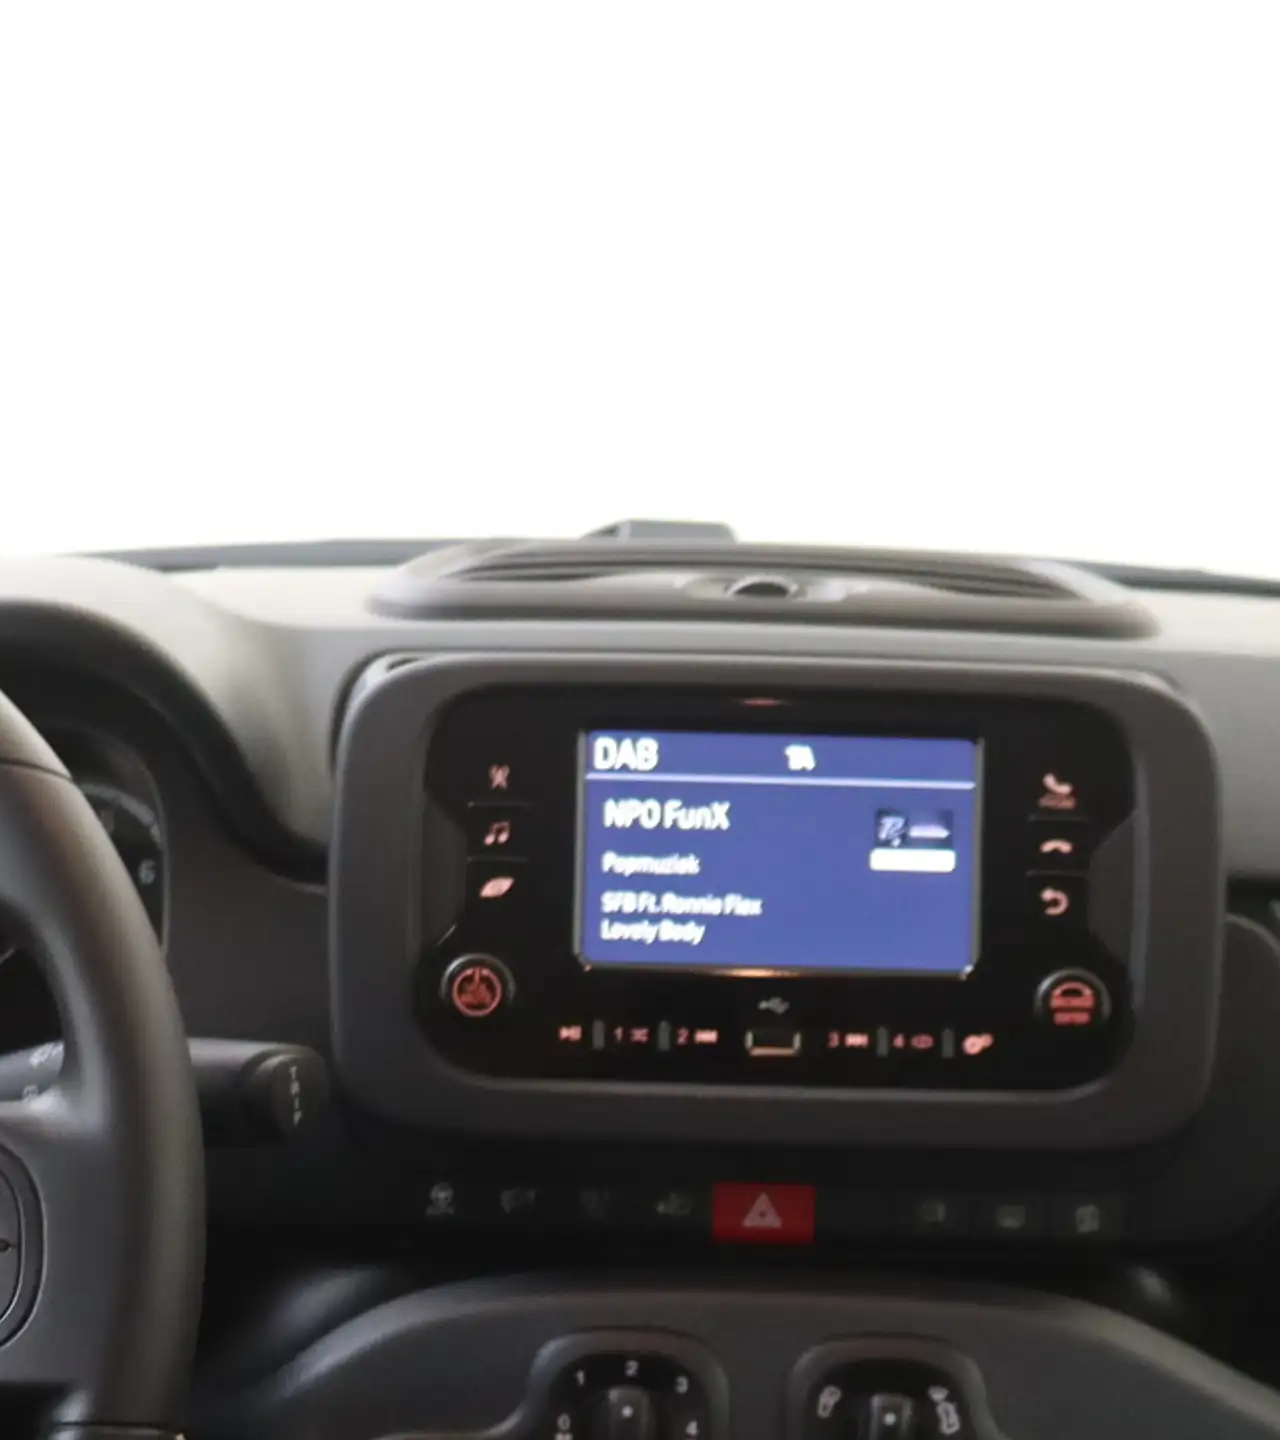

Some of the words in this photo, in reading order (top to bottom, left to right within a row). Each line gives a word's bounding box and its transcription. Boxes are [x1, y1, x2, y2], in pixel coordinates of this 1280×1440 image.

[593, 737, 659, 770] DAB
[603, 798, 661, 829] NPO
[663, 799, 731, 831] FunX
[600, 919, 658, 945] Lovely
[659, 920, 706, 945] Body
[676, 1028, 689, 1045] 2
[575, 1368, 585, 1386] 1
[624, 1359, 640, 1377] 2
[674, 1375, 689, 1394] 3
[685, 1419, 699, 1437] 4
